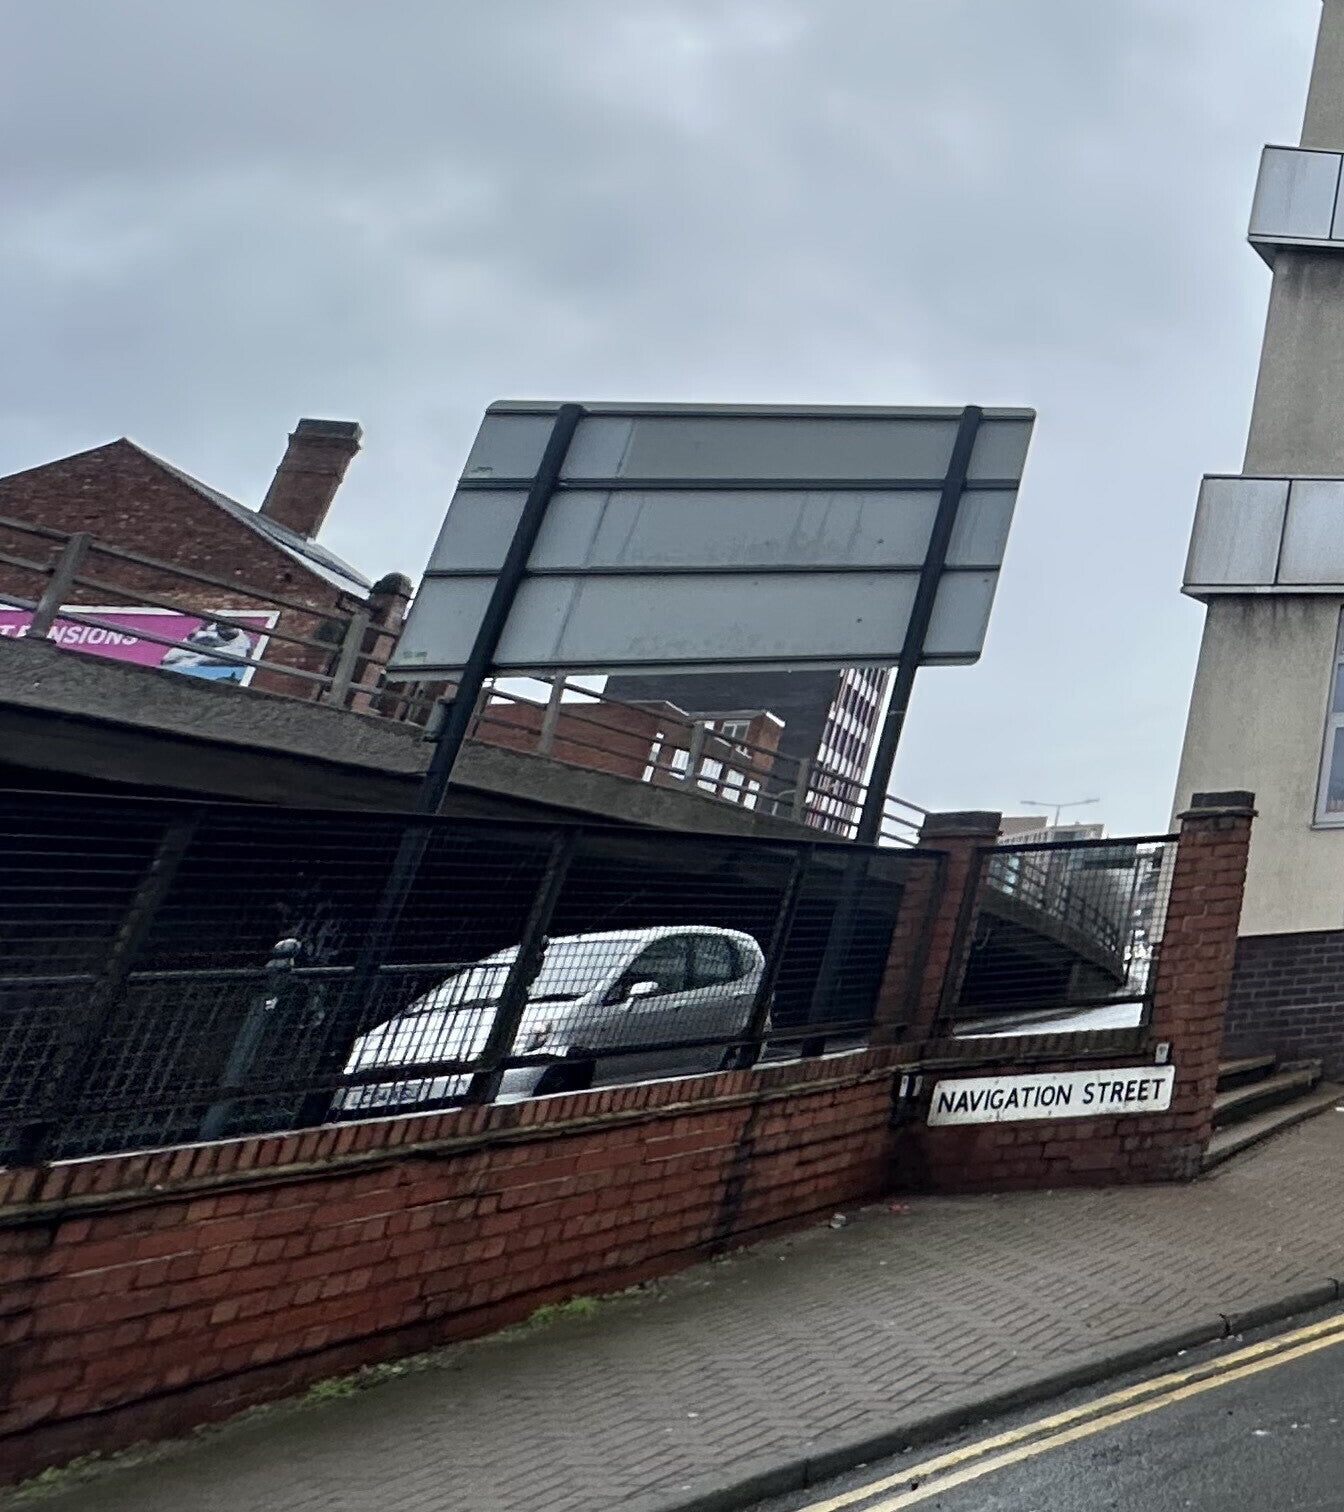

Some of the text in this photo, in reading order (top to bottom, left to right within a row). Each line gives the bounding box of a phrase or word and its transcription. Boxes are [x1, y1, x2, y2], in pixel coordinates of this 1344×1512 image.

[17, 623, 139, 646] NSIONS
[937, 1078, 1166, 1113] NAVIGATION STREET
